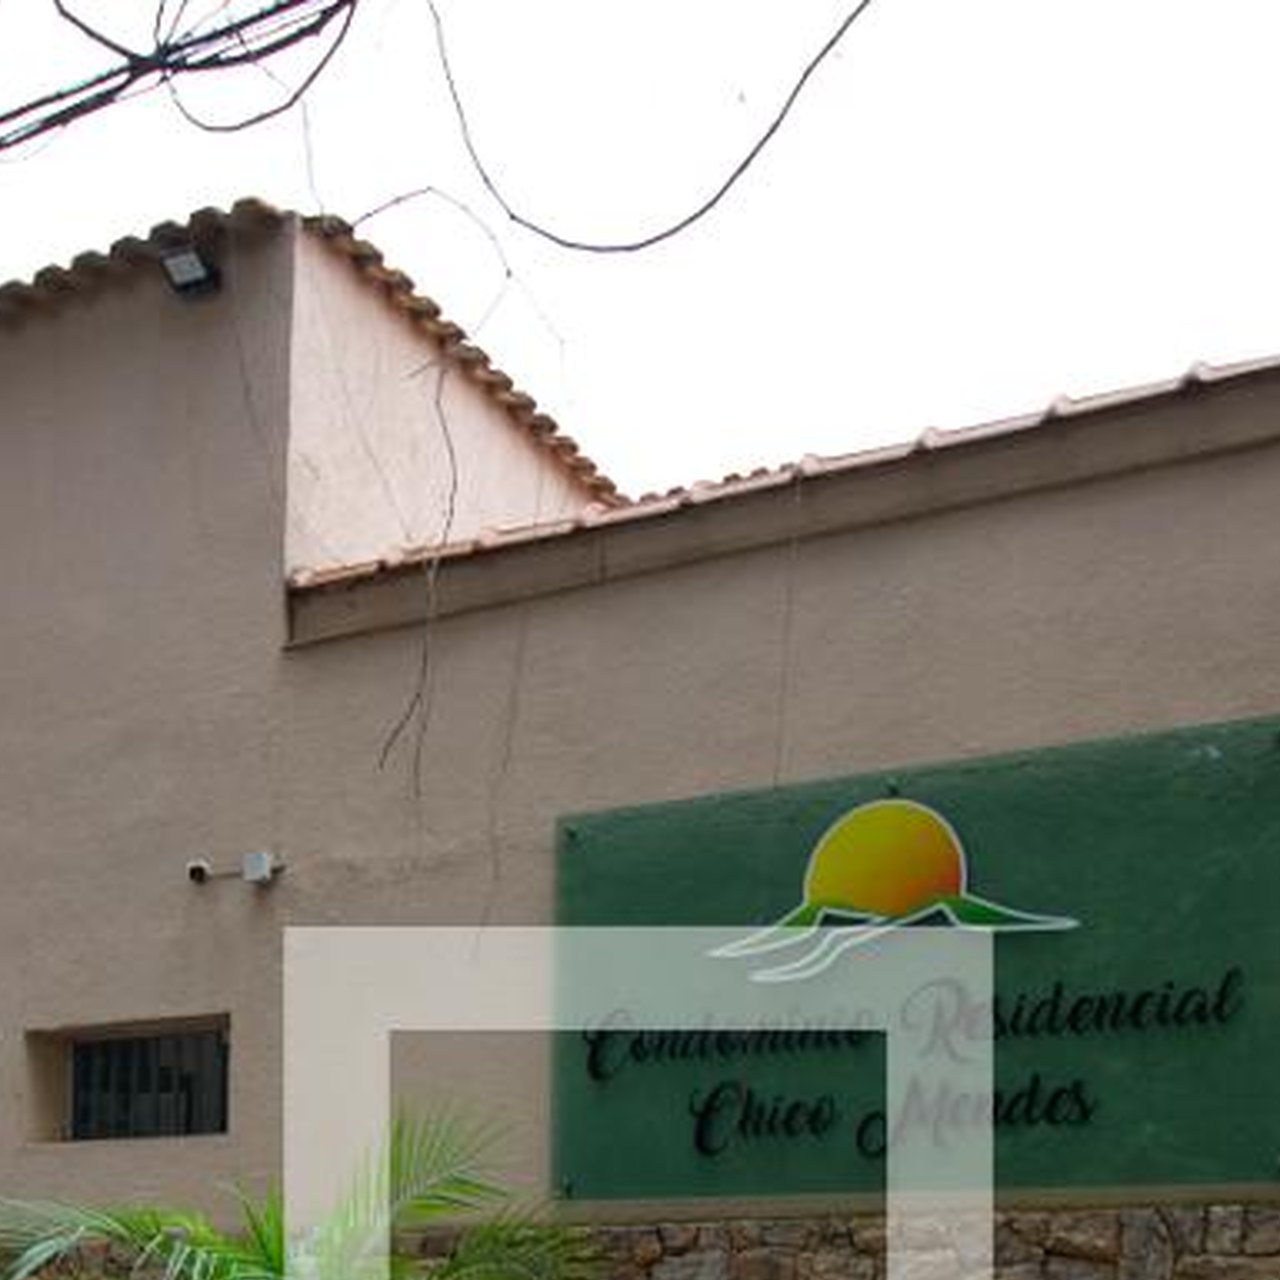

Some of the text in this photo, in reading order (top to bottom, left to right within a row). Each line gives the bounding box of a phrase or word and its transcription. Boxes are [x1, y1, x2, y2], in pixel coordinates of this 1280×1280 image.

[902, 968, 1244, 1062] Residencial
[688, 1074, 1094, 1158] Chico Mendes
